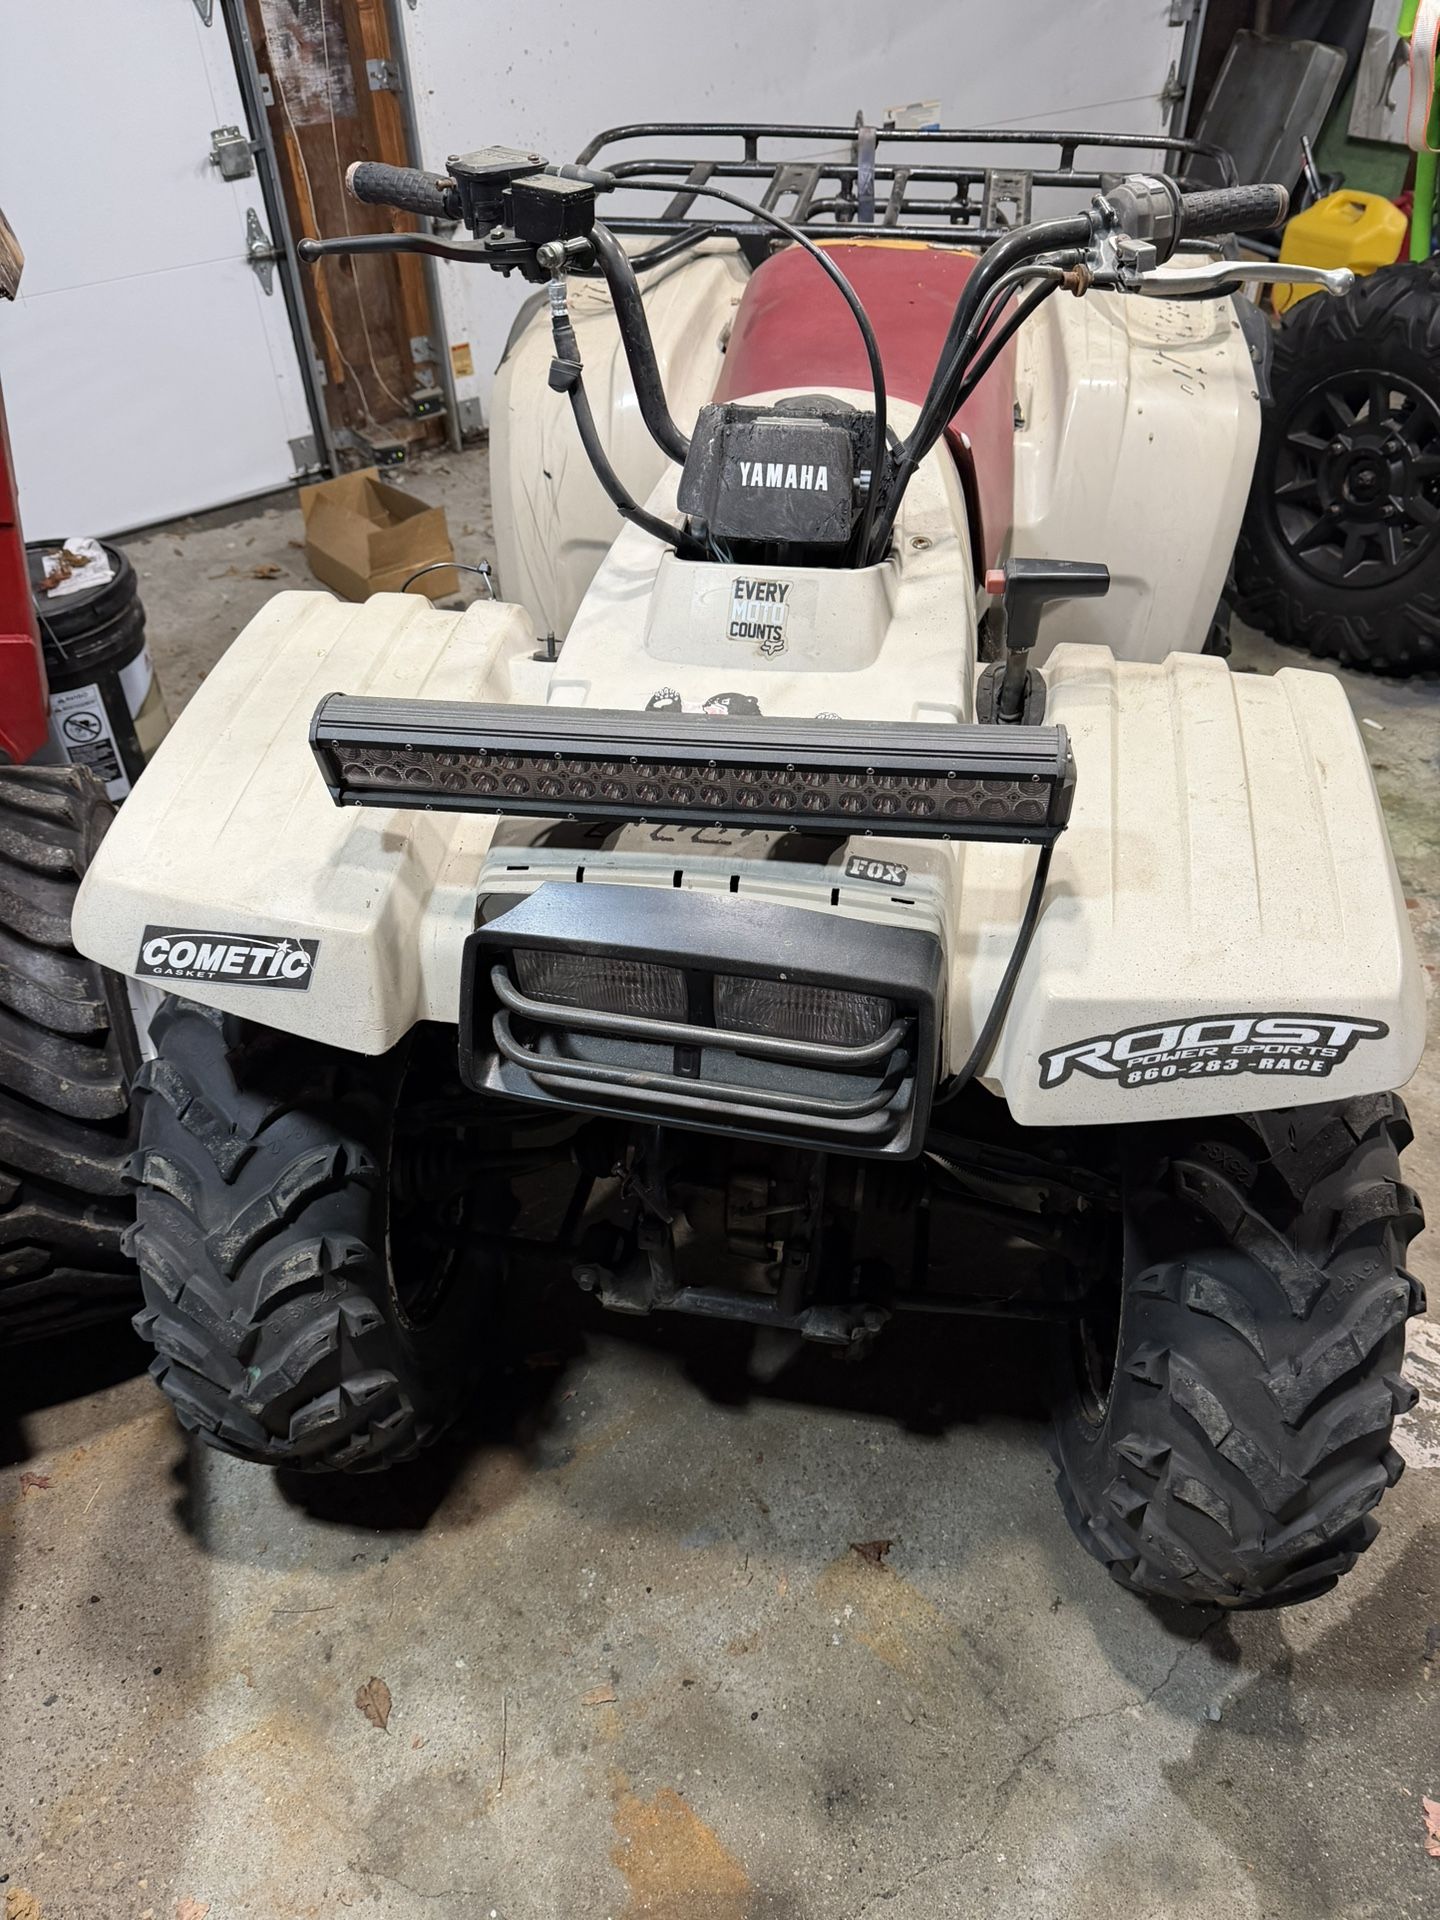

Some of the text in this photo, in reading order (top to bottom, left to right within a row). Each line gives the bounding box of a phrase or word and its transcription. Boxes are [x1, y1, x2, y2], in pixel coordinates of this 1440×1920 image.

[740, 462, 828, 491] YAMAHA
[734, 580, 790, 603] EVERY
[732, 601, 785, 623] MOTO
[729, 622, 783, 641] COUNTS
[850, 859, 902, 882] FOX
[143, 938, 311, 979] COMETIC
[153, 967, 216, 979] GASKET
[1047, 1018, 1380, 1082] ROOST
[1126, 1045, 1339, 1069] POWER SPORTS
[1127, 1058, 1239, 1084] 860-283
